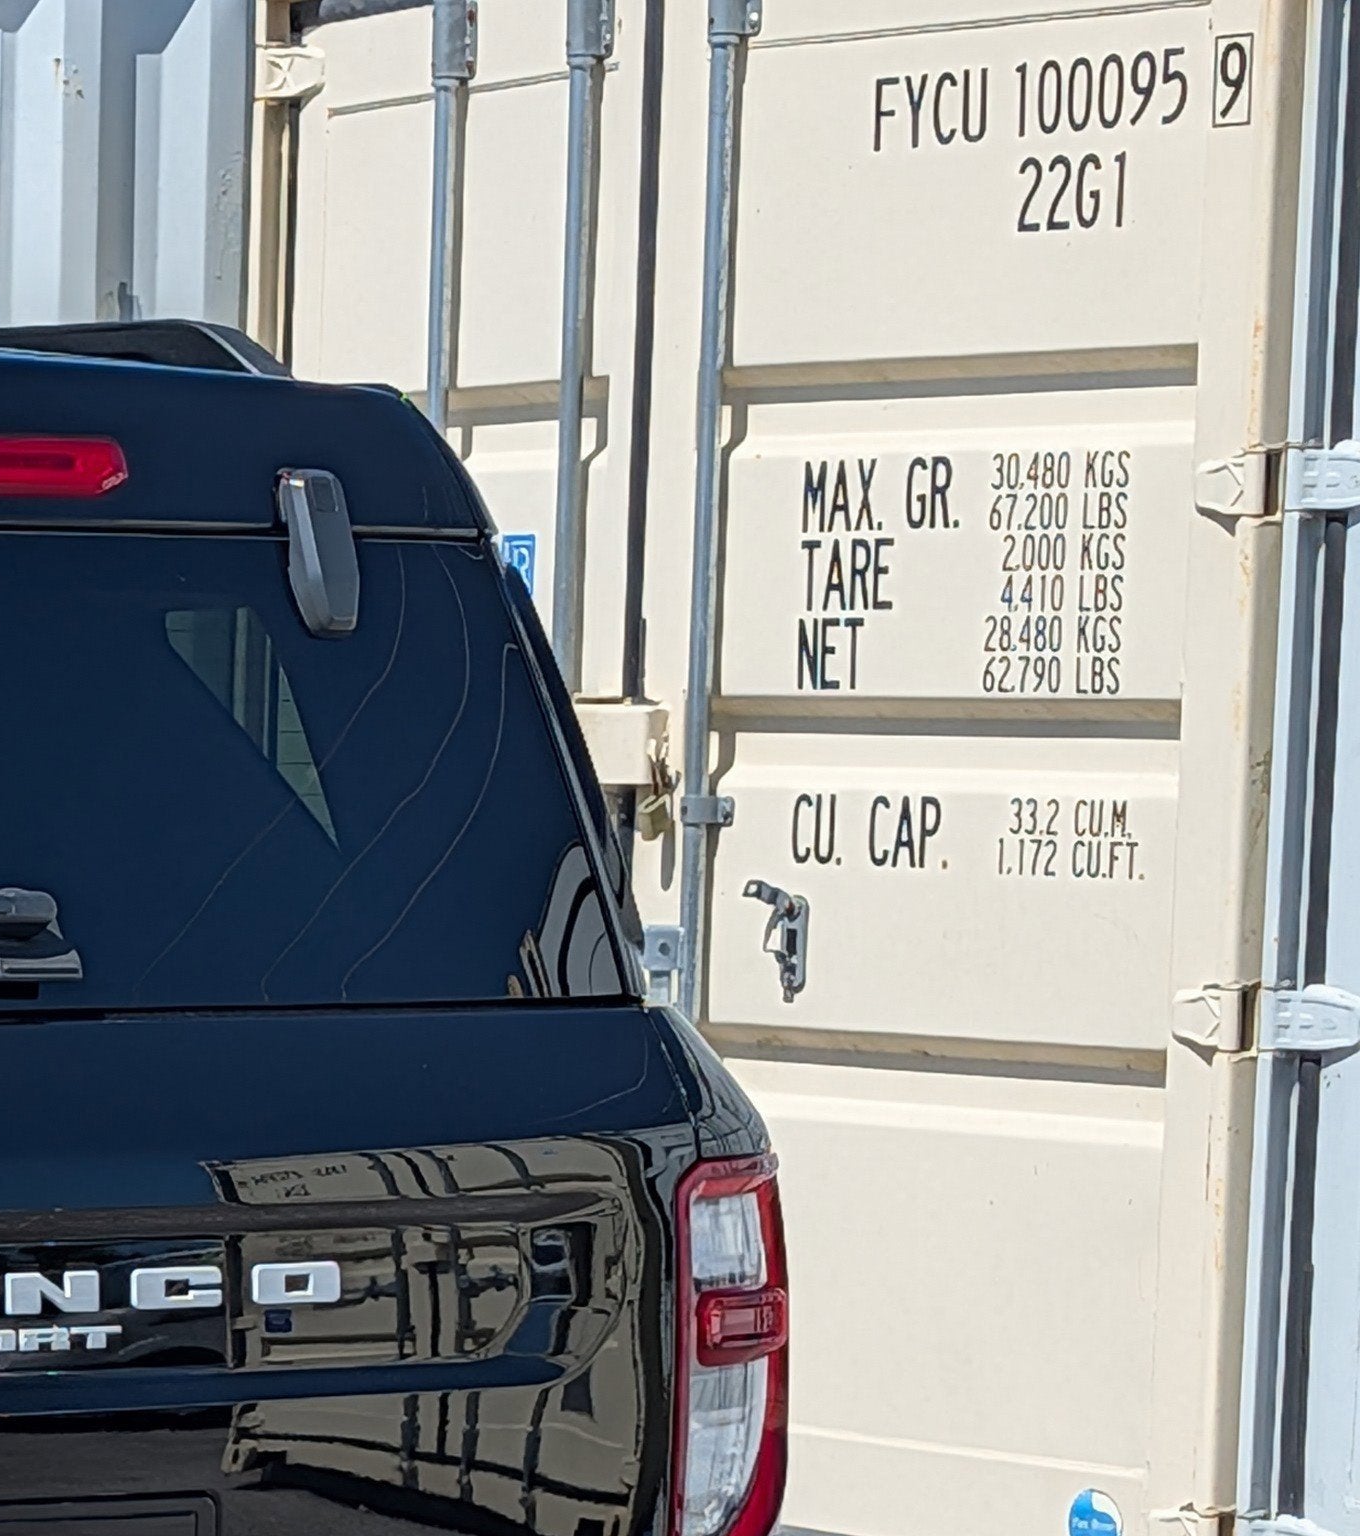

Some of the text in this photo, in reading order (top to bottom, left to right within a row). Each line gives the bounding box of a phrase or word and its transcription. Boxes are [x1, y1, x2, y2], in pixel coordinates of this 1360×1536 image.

[873, 41, 1246, 152] FYCU 100095 9
[1017, 150, 1126, 232] 22G1
[801, 458, 882, 533] MAX.
[906, 455, 960, 529] GR.
[1084, 450, 1131, 488] KGS
[1082, 492, 1129, 530] LBS
[801, 537, 895, 612] TARE
[1080, 533, 1126, 571] KGS
[1078, 574, 1124, 612] LBS
[797, 617, 865, 690] NET
[1076, 615, 1122, 653] KGS
[1075, 656, 1121, 695] LBS
[791, 793, 842, 866] CU.
[868, 795, 948, 870] CAP.
[1008, 798, 1060, 836] 33.2
